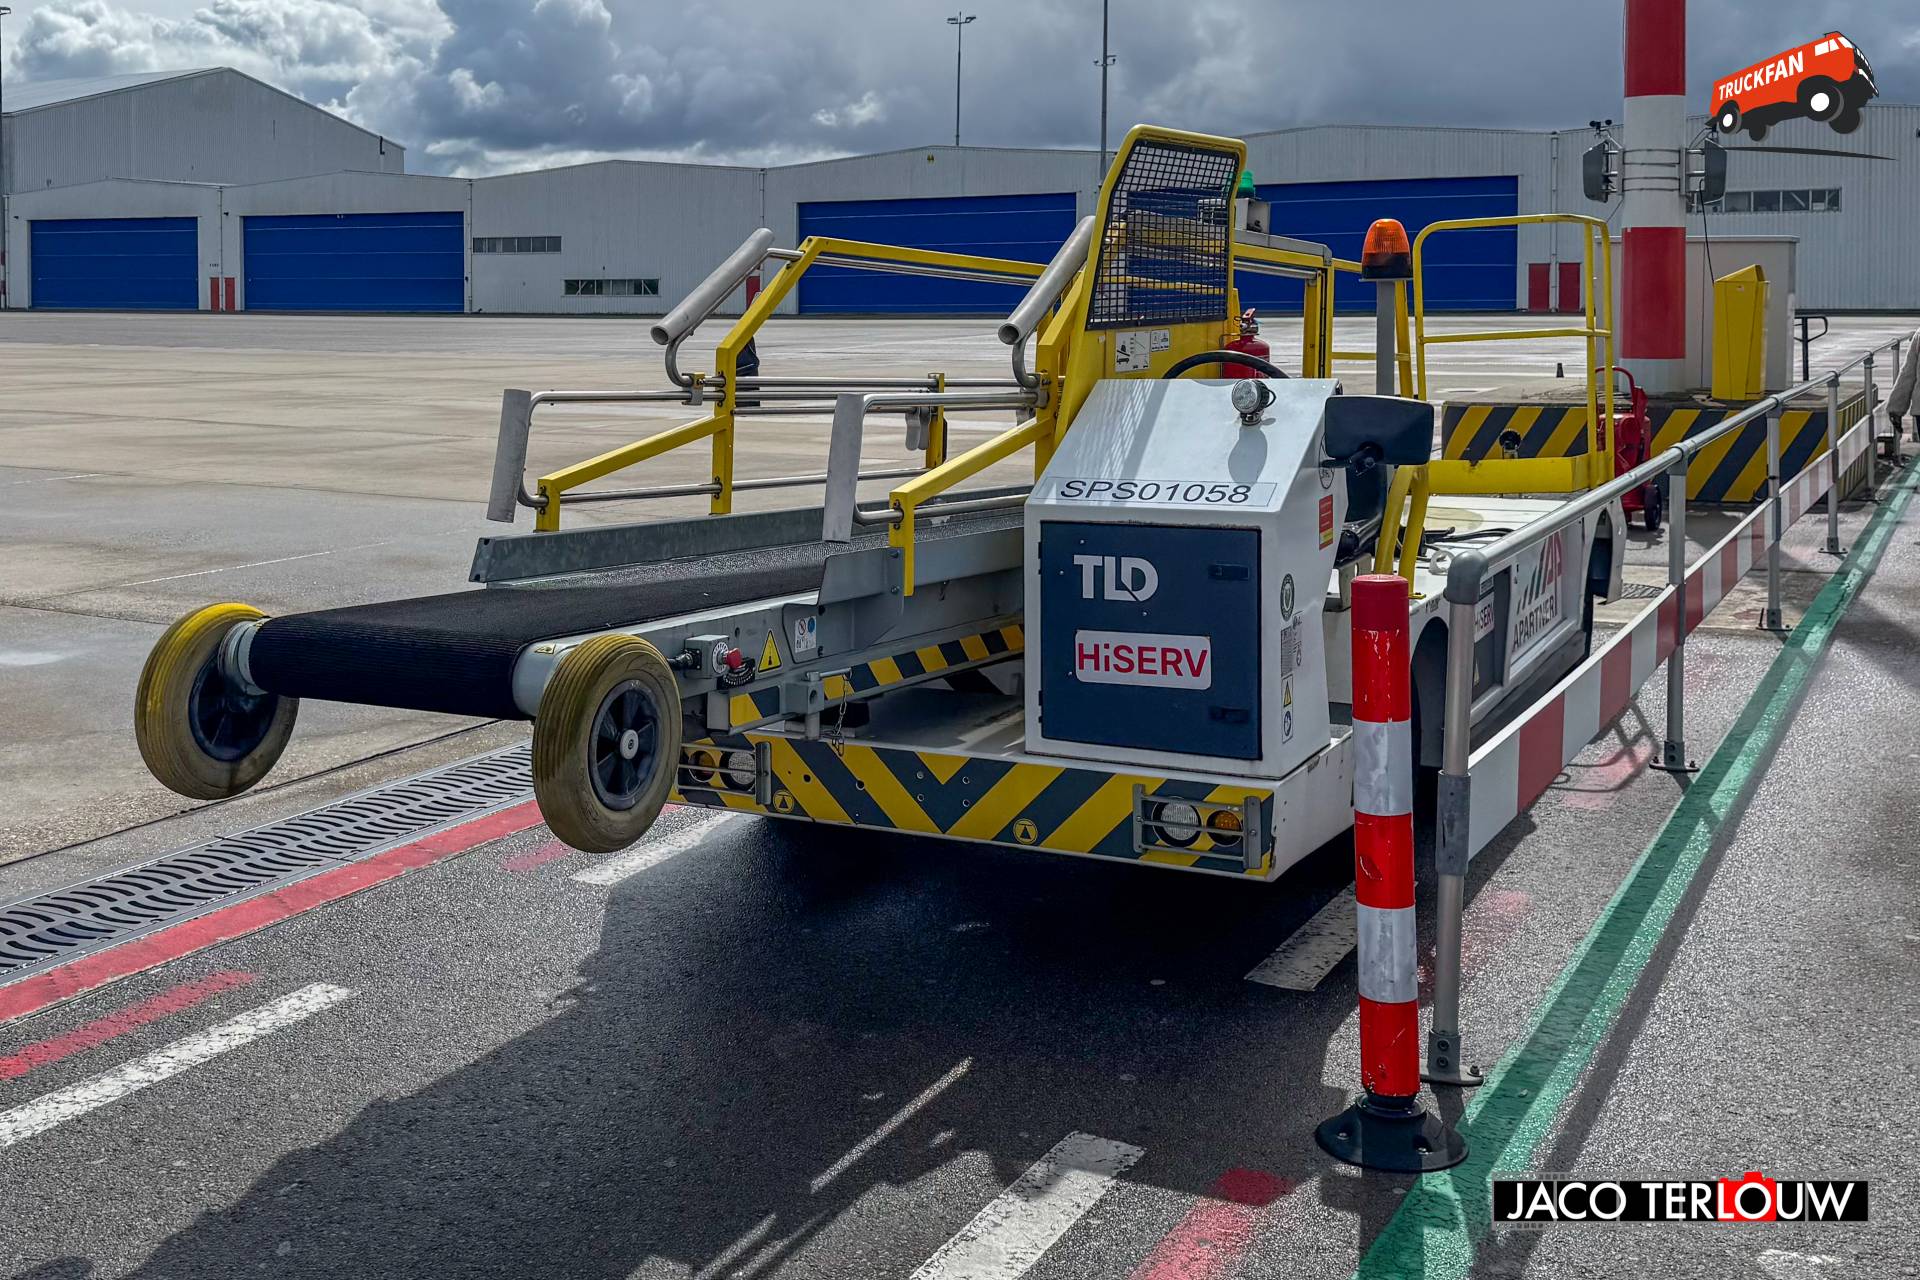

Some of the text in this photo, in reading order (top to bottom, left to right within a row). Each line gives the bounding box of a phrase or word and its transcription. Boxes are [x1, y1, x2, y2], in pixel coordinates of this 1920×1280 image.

[1060, 480, 1251, 504] SPS01058
[1073, 554, 1159, 602] TLD
[1512, 594, 1555, 653] APARTNER
[1077, 643, 1208, 678] HiSERV
